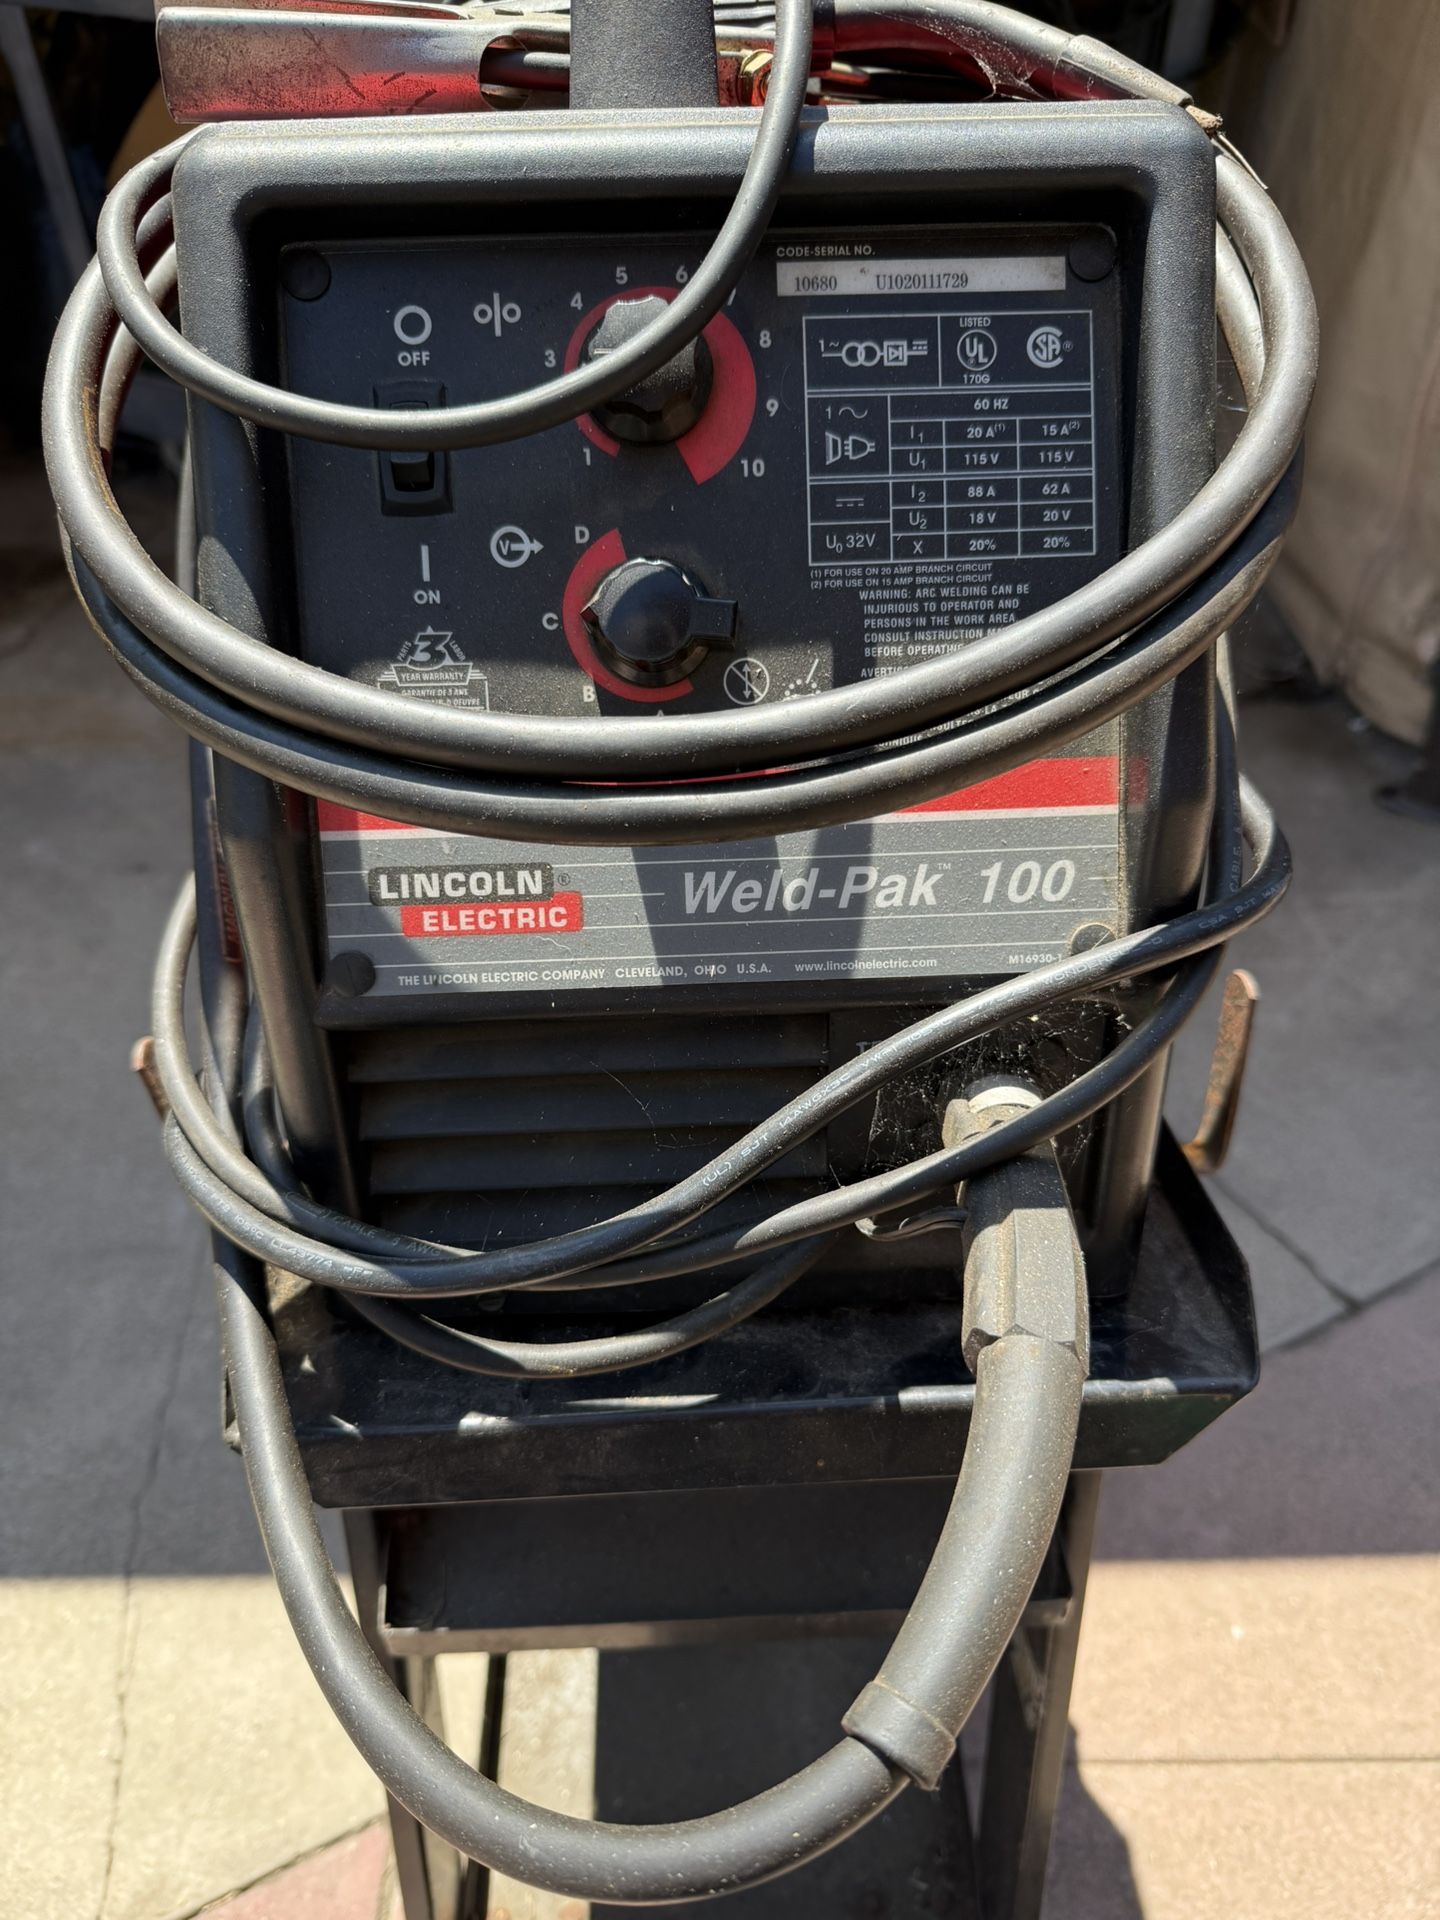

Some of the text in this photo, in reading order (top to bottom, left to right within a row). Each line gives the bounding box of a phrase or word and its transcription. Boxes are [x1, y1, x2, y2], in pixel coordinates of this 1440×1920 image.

[776, 244, 876, 258] CODE-SERIAL NO.
[615, 267, 628, 285] 5
[675, 265, 688, 283] 6
[794, 272, 969, 292] 10680 U1020111729
[570, 292, 583, 310] 4
[959, 317, 991, 328] LISTED
[759, 331, 772, 348] 8
[397, 351, 431, 367] OFF
[544, 350, 556, 368] 3
[963, 374, 990, 385] 170G
[766, 398, 779, 417] 9
[974, 398, 1009, 410] 60 HZ
[967, 427, 983, 439] 20
[1042, 424, 1058, 436] 15
[583, 448, 592, 466] 1
[964, 453, 1000, 465] 115 V
[1039, 450, 1075, 463] 115 V
[741, 460, 766, 477] 10
[967, 486, 996, 498] 88 A
[1042, 483, 1071, 495] 62 A
[969, 512, 997, 525] 18 V
[1043, 510, 1072, 522] 20 V
[575, 527, 590, 544] D
[846, 533, 876, 548] 32V
[1043, 537, 1071, 549] 20%
[912, 541, 924, 555] X
[969, 539, 997, 551] 20%
[810, 562, 993, 579] (1) FOR USE ON 20 AMP BRANCH CIRCUIT
[810, 573, 993, 590] (2) FOR USE ON 15 AMP BRANCH CIRCUIT
[414, 590, 441, 605] ON
[859, 584, 1030, 601] WARNING: ARC WELDING CAN BE
[864, 598, 1020, 615] INJURIOUS TO OPERATOR AND
[542, 613, 560, 631] C
[864, 617, 911, 629] PERSONS
[915, 616, 927, 627] IN
[931, 615, 950, 626] THE
[954, 614, 985, 625] WORK
[864, 631, 910, 643] CONSULT
[914, 628, 983, 641] INSTRUCTION
[397, 640, 412, 661] PARTS
[407, 631, 453, 671] 3
[448, 640, 466, 661] LABOR
[864, 646, 903, 658] BEFORE
[401, 672, 465, 681] YEAR WARRANTY
[583, 686, 595, 703] B
[379, 870, 543, 900] LINCOLN
[979, 859, 1075, 903] 100
[422, 906, 569, 933] ELECTRIC
[398, 953, 1062, 987] THE LINCOLN ELECTRIC COMPANY CLEVELAND, OHIO U.S.A. www.lincolnelectric.com M16930-1
[702, 1161, 733, 1186] (UL)
[740, 1134, 769, 1157] SJT
